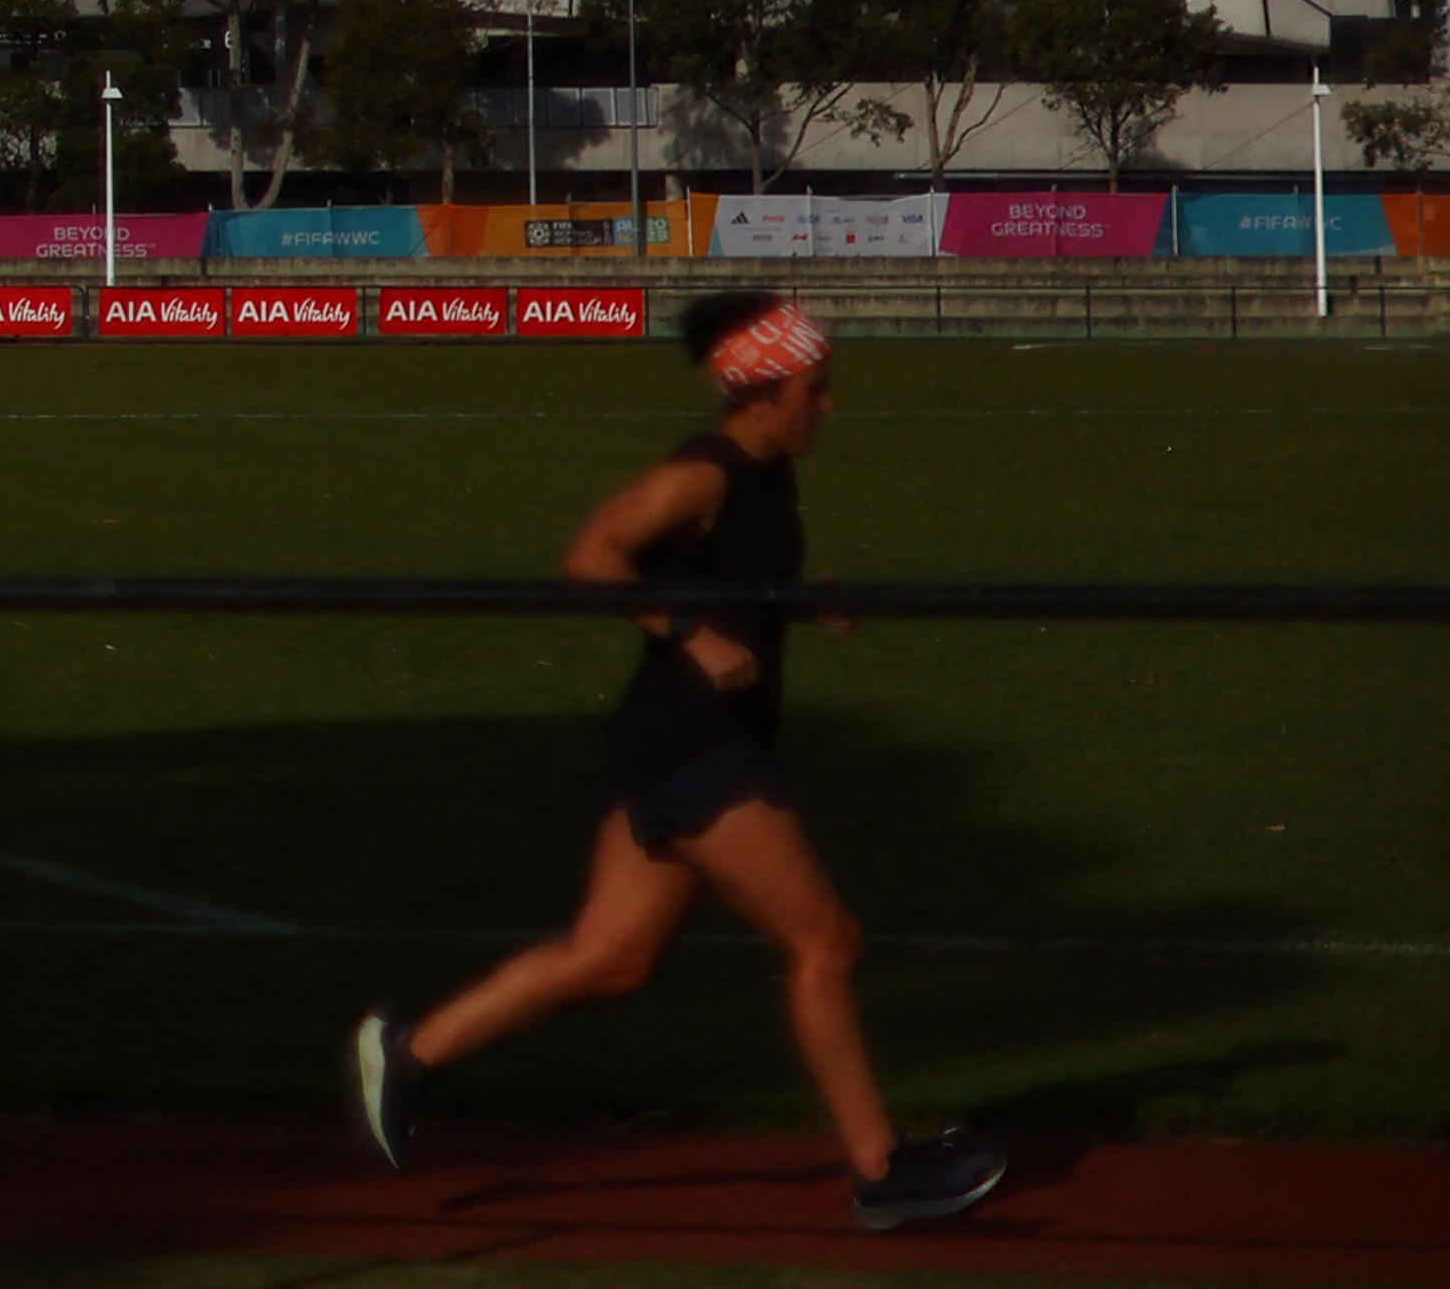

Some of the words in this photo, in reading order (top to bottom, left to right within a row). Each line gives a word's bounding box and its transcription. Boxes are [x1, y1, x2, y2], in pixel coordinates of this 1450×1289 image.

[901, 214, 924, 224] VISA
[1009, 203, 1087, 220] BEYOND
[990, 221, 1104, 238] GREATNESS
[1239, 215, 1343, 232] #FIFAWC
[53, 226, 131, 242] BEYOD
[280, 230, 381, 247] #FIFAWWC
[35, 242, 148, 258] GREATNESS
[8, 297, 66, 330] Vitality
[105, 300, 157, 322] AIA
[160, 297, 218, 331] Vitality
[238, 300, 290, 323] AIA
[293, 298, 351, 331] Vitality
[386, 300, 438, 321] AIA
[442, 298, 500, 329] Vitality
[523, 301, 575, 322] AIA
[579, 298, 637, 330] Vitality
